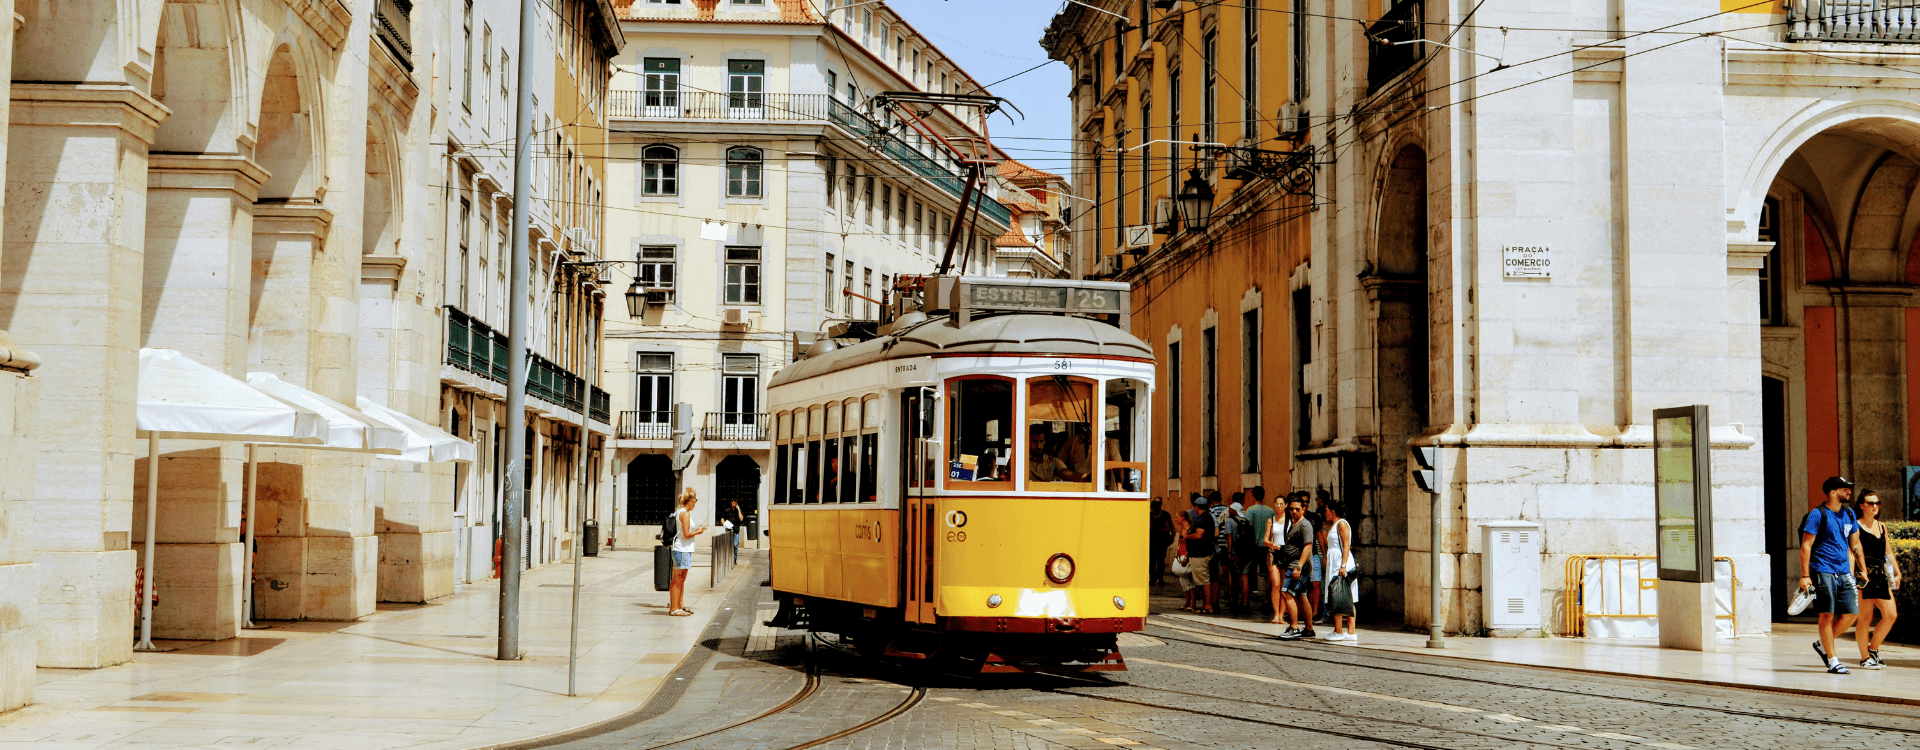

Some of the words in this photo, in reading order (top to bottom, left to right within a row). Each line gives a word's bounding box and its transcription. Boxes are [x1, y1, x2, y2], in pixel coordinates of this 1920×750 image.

[1512, 246, 1543, 255] PRAÇA
[1505, 258, 1550, 267] COMERCIO
[976, 287, 1059, 302] ESTRELA
[1078, 289, 1106, 308] 25
[895, 364, 917, 373] ENTRADA
[1054, 360, 1072, 370] 581
[950, 470, 960, 478] 01
